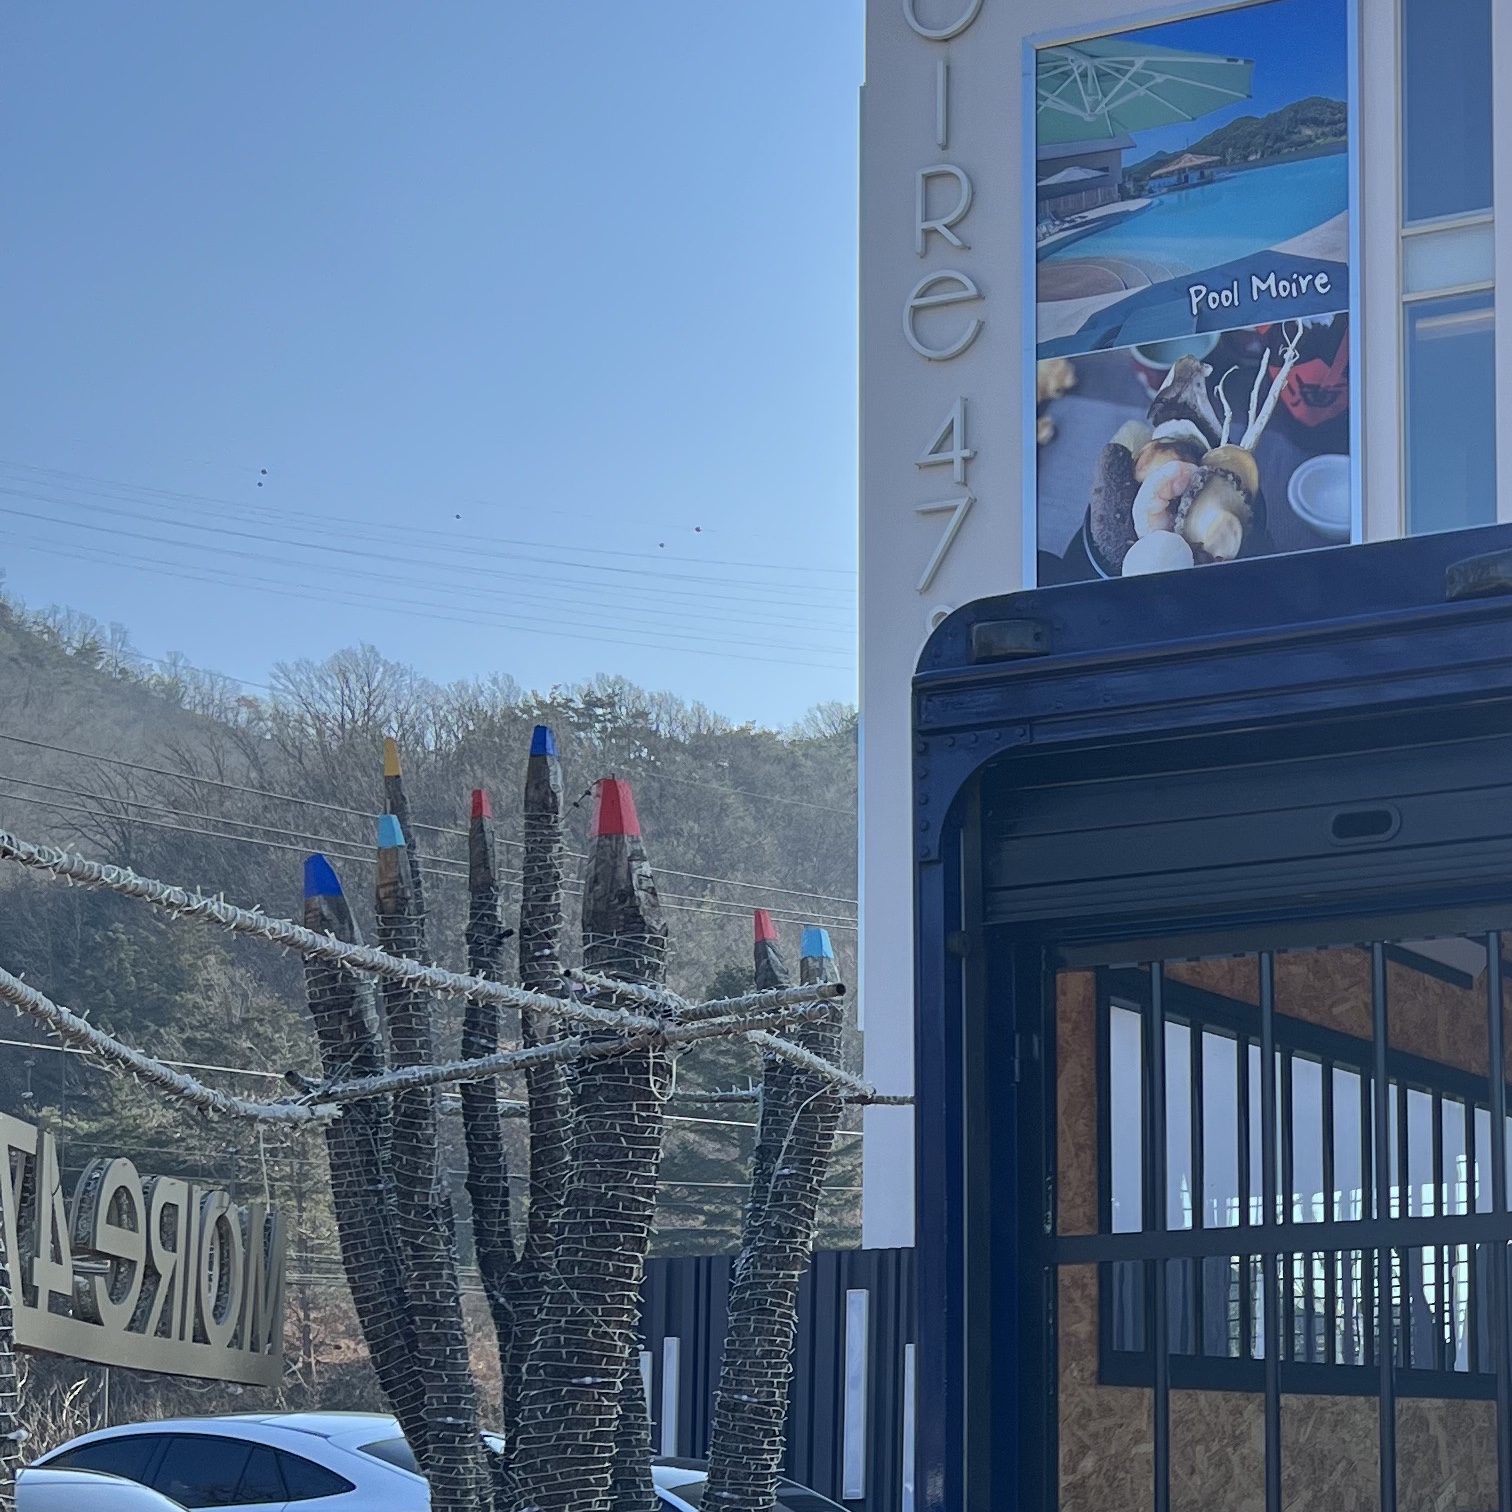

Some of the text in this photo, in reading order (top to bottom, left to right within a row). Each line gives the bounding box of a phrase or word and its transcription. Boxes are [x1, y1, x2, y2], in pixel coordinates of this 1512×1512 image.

[1188, 272, 1331, 316] Pool Moire
[915, 397, 977, 593] 47
